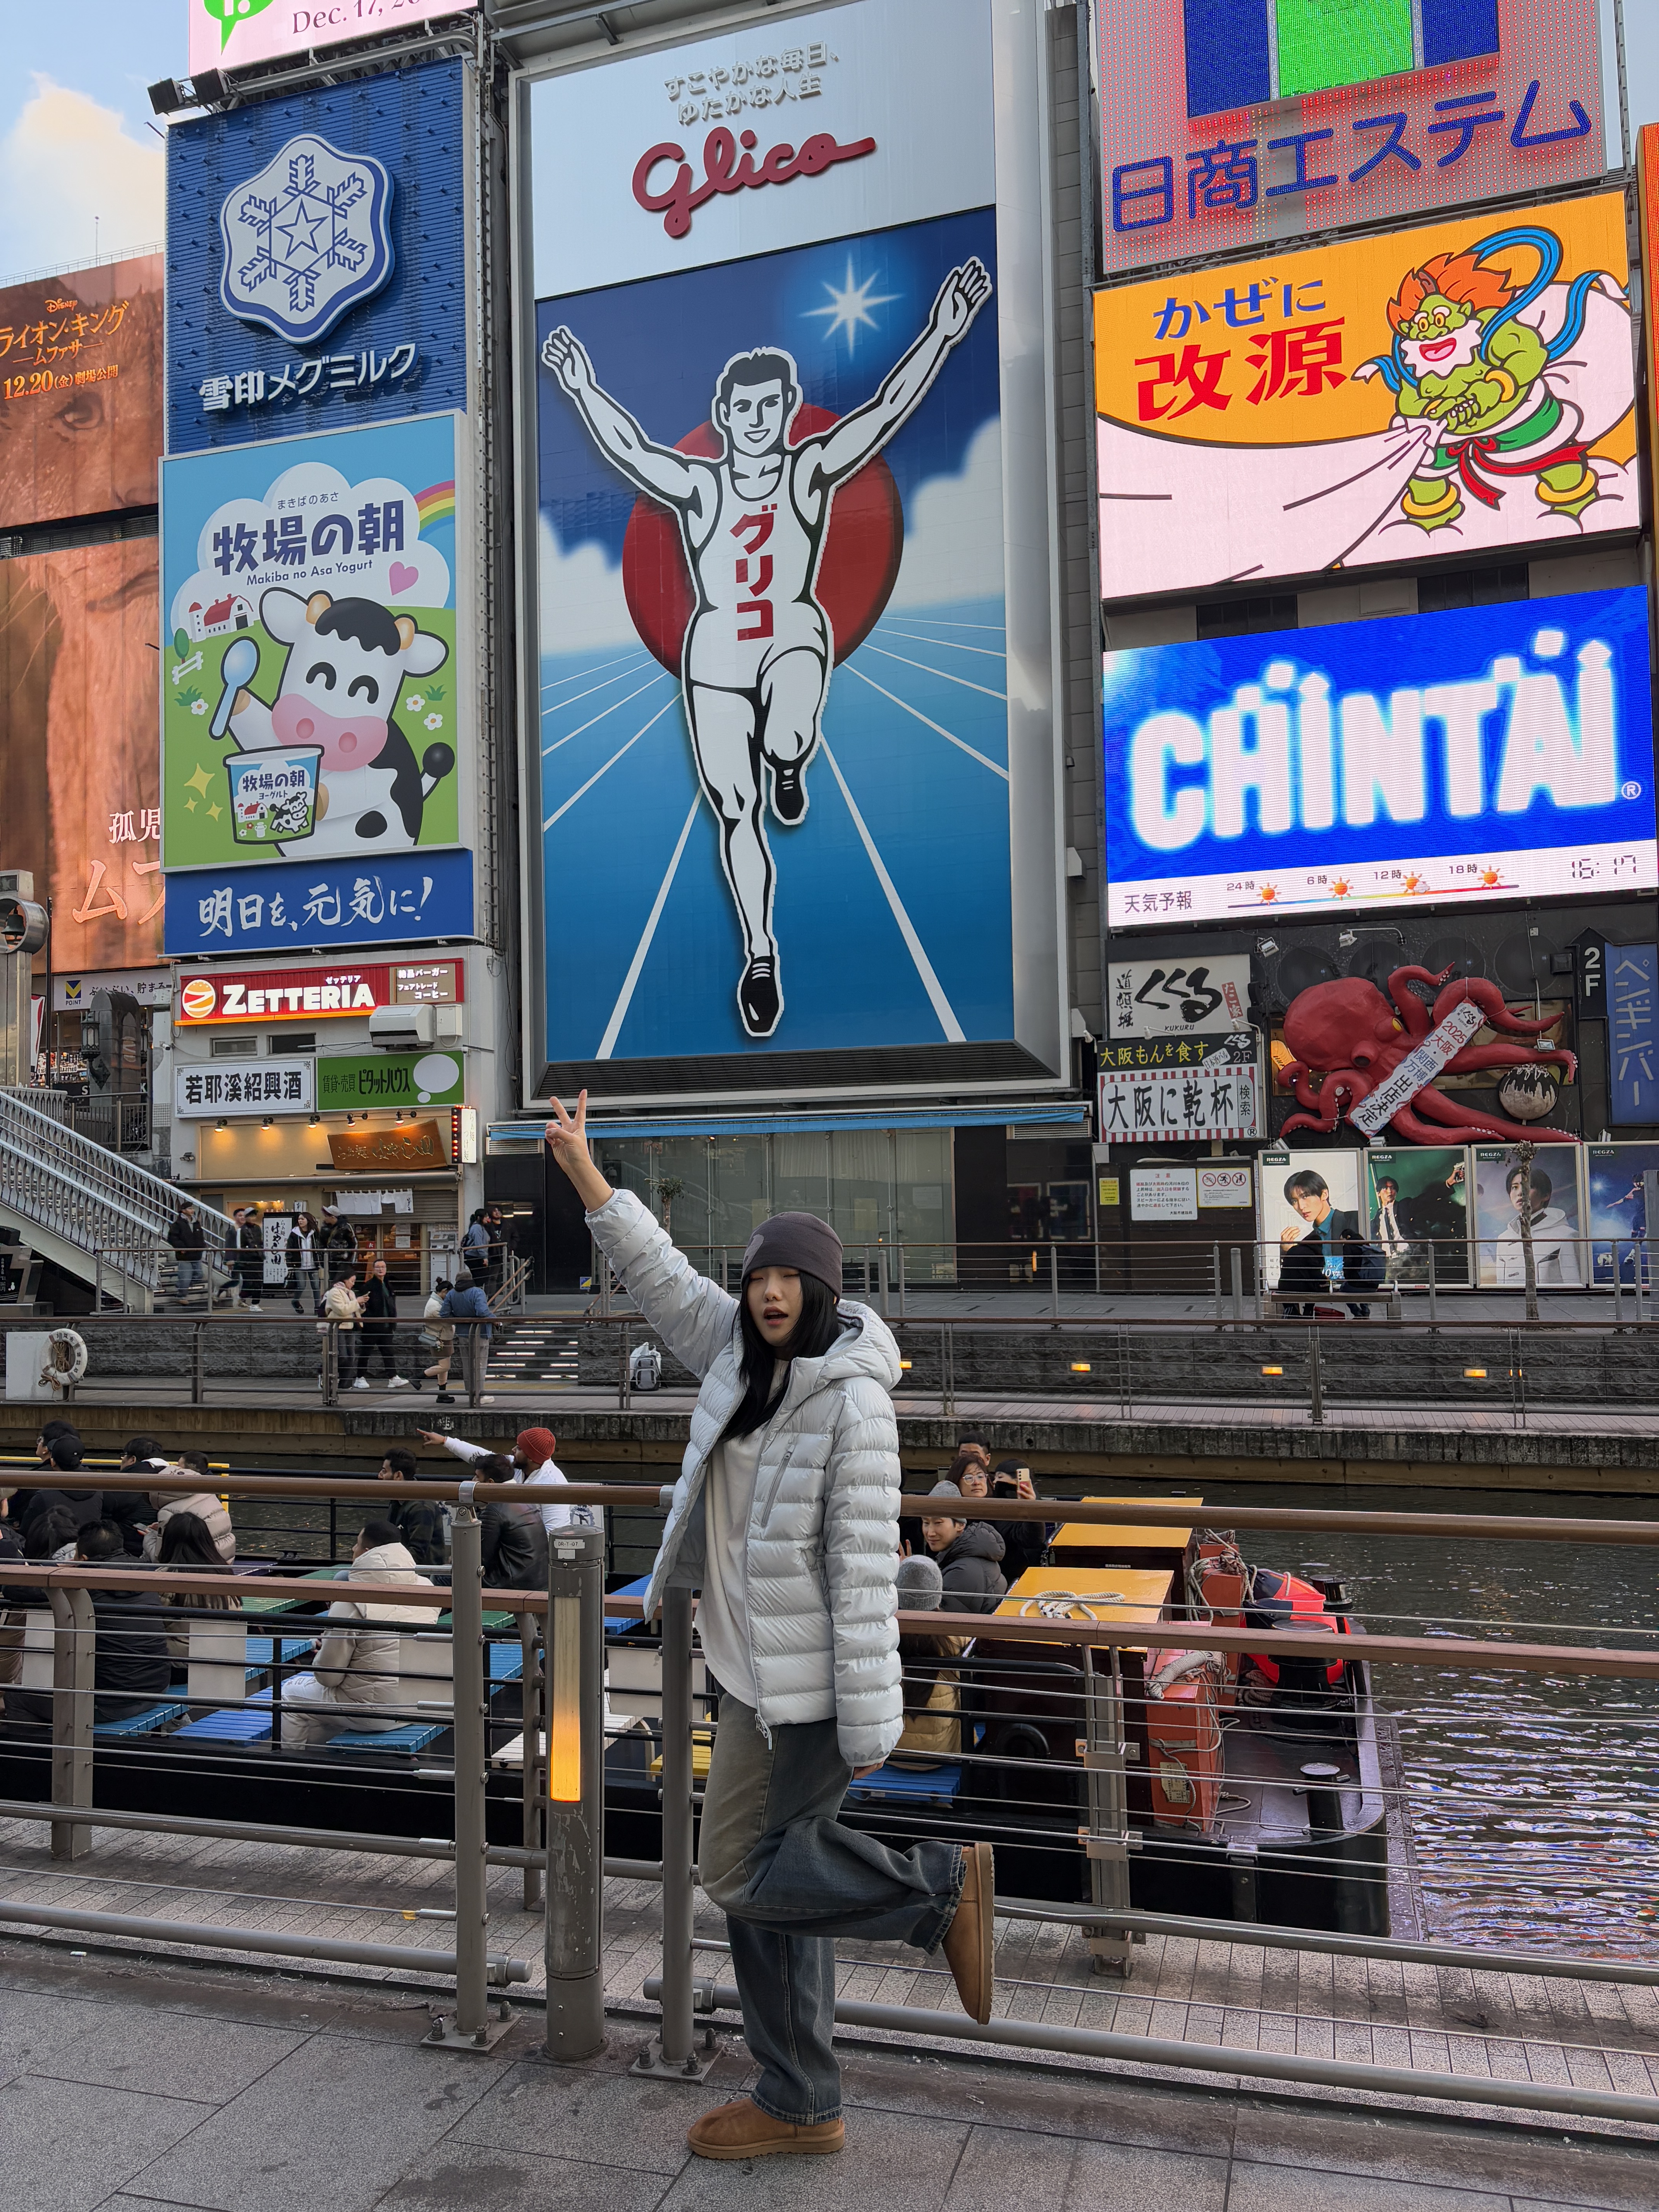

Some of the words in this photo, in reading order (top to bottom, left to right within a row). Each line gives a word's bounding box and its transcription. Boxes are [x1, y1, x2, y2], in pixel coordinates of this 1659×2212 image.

[293, 8, 347, 34] Dec.
[664, 40, 838, 101] すこやかな毎日、
[678, 72, 822, 125] ゆたかな人生
[1112, 79, 1592, 232] 日商エステム
[1152, 276, 1326, 339] かぜに
[0, 300, 129, 357] ライオン・キング
[75, 364, 118, 385] 劇場公開
[199, 343, 417, 411] 雪印メグミルク
[1134, 316, 1348, 421] 改源
[277, 491, 339, 510] まきばのあさ
[213, 500, 404, 576] 牧場の朝
[246, 572, 289, 586] Makiba
[293, 570, 307, 580] no
[311, 565, 333, 577] Asa
[336, 559, 373, 575] Yogurt
[730, 503, 778, 641] グリコ
[1131, 629, 1617, 850] CHINTAI
[242, 769, 306, 793] 牧場の朝
[259, 790, 288, 800] ヨーグルト
[1307, 875, 1328, 885] 6時
[1374, 869, 1402, 880] 12時
[1449, 863, 1478, 874] 18時
[1572, 855, 1636, 879] 16:17
[1226, 880, 1255, 892] 24時
[1124, 890, 1194, 914] 天気予報
[325, 975, 361, 984] ゼッテリア
[1584, 947, 1601, 997] 2F
[222, 983, 376, 1015] ZETTERIA
[398, 982, 438, 991] フェアトレード
[415, 991, 448, 999] コーヒー
[1116, 969, 1134, 1029] 道頓堀
[1134, 967, 1223, 1023] くくる
[1224, 1034, 1251, 1049] くくる
[1441, 1021, 1468, 1044] 2025
[1614, 959, 1654, 1106] ペンギンバー
[1100, 1041, 1209, 1067] 大阪もんを食す
[1204, 1049, 1229, 1070] 日本酒バル
[1233, 1050, 1252, 1063] 2F
[323, 1073, 356, 1094] 賃貸・売買
[358, 1068, 411, 1095] ピタットハウス
[1108, 1079, 1233, 1129] 大阪に乾杯
[1239, 1084, 1251, 1116] 検索
[1358, 1074, 1413, 1127] 出店決定
